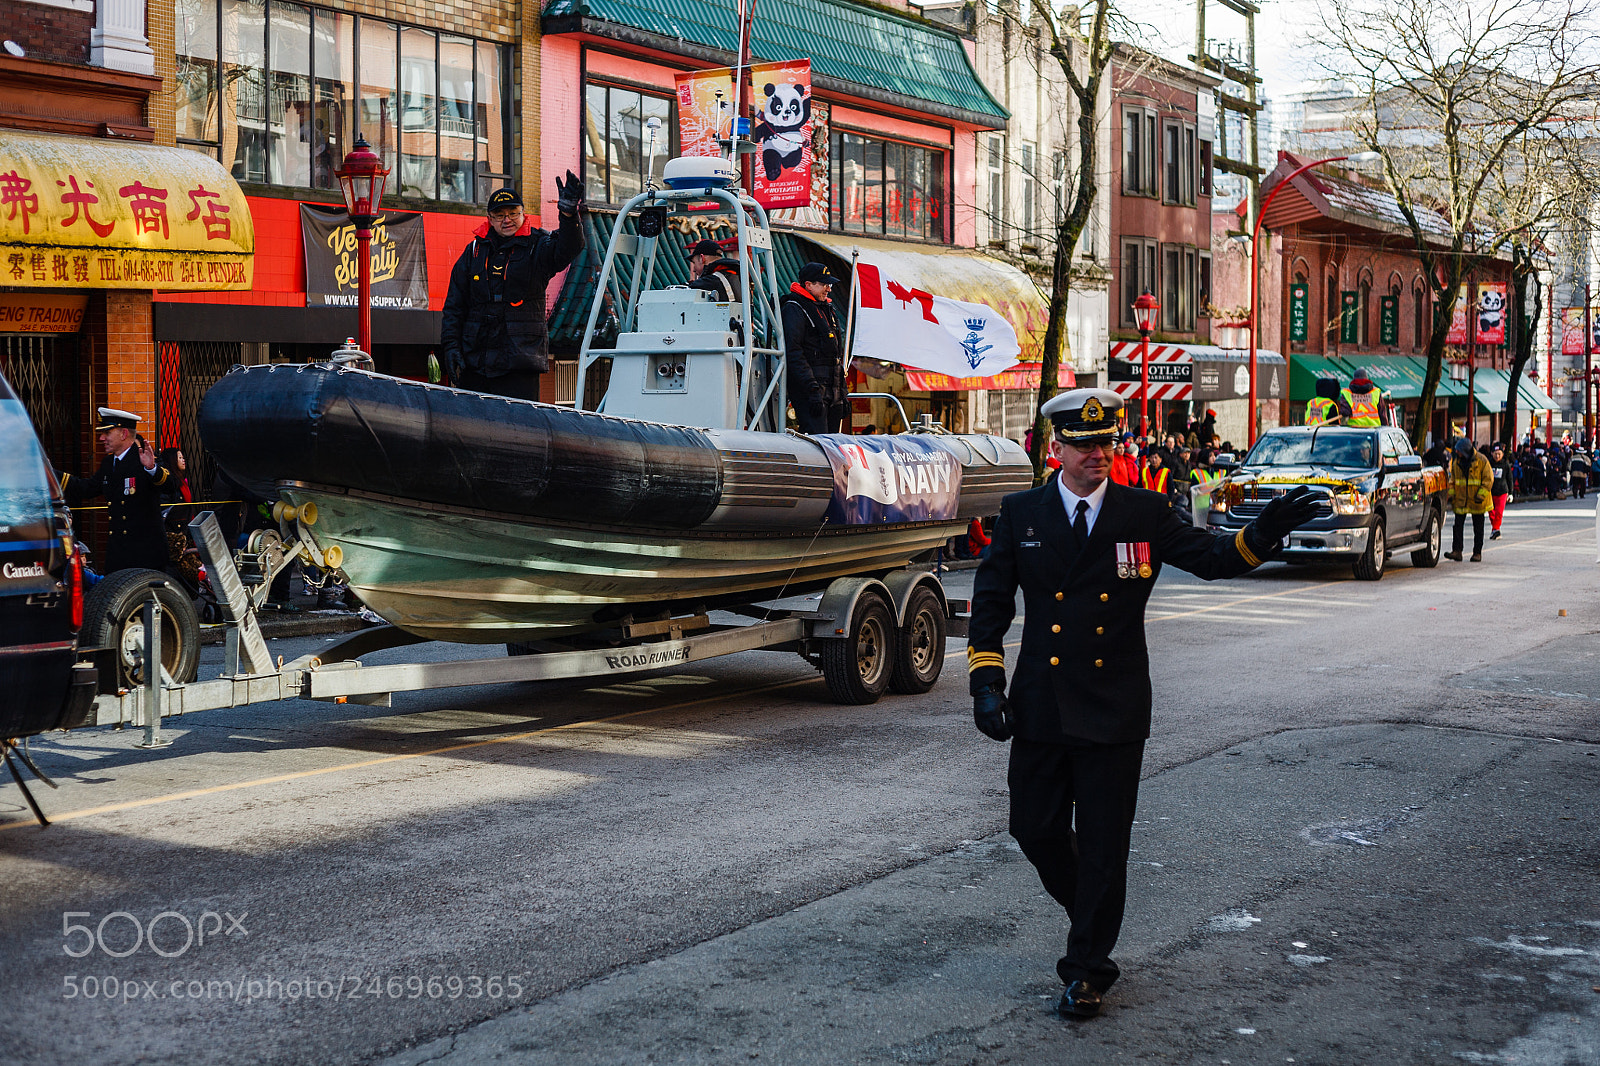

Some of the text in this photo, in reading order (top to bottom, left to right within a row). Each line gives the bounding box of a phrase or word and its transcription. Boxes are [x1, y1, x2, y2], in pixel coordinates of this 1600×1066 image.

[327, 214, 389, 255] Vean
[8, 253, 89, 282] 零售批發
[98, 258, 121, 281] TEL:
[123, 259, 174, 282] 604-685-8717
[180, 261, 194, 282] 254
[207, 262, 246, 283] PENDER
[335, 246, 399, 291] Suply
[324, 294, 413, 308] WWW.VENSUPPLY.CA
[28, 307, 83, 323] TRADING
[680, 312, 686, 325] 1
[898, 464, 950, 494] NAVY
[3, 562, 45, 578] Canada
[606, 645, 691, 669] ROAD RUNNER
